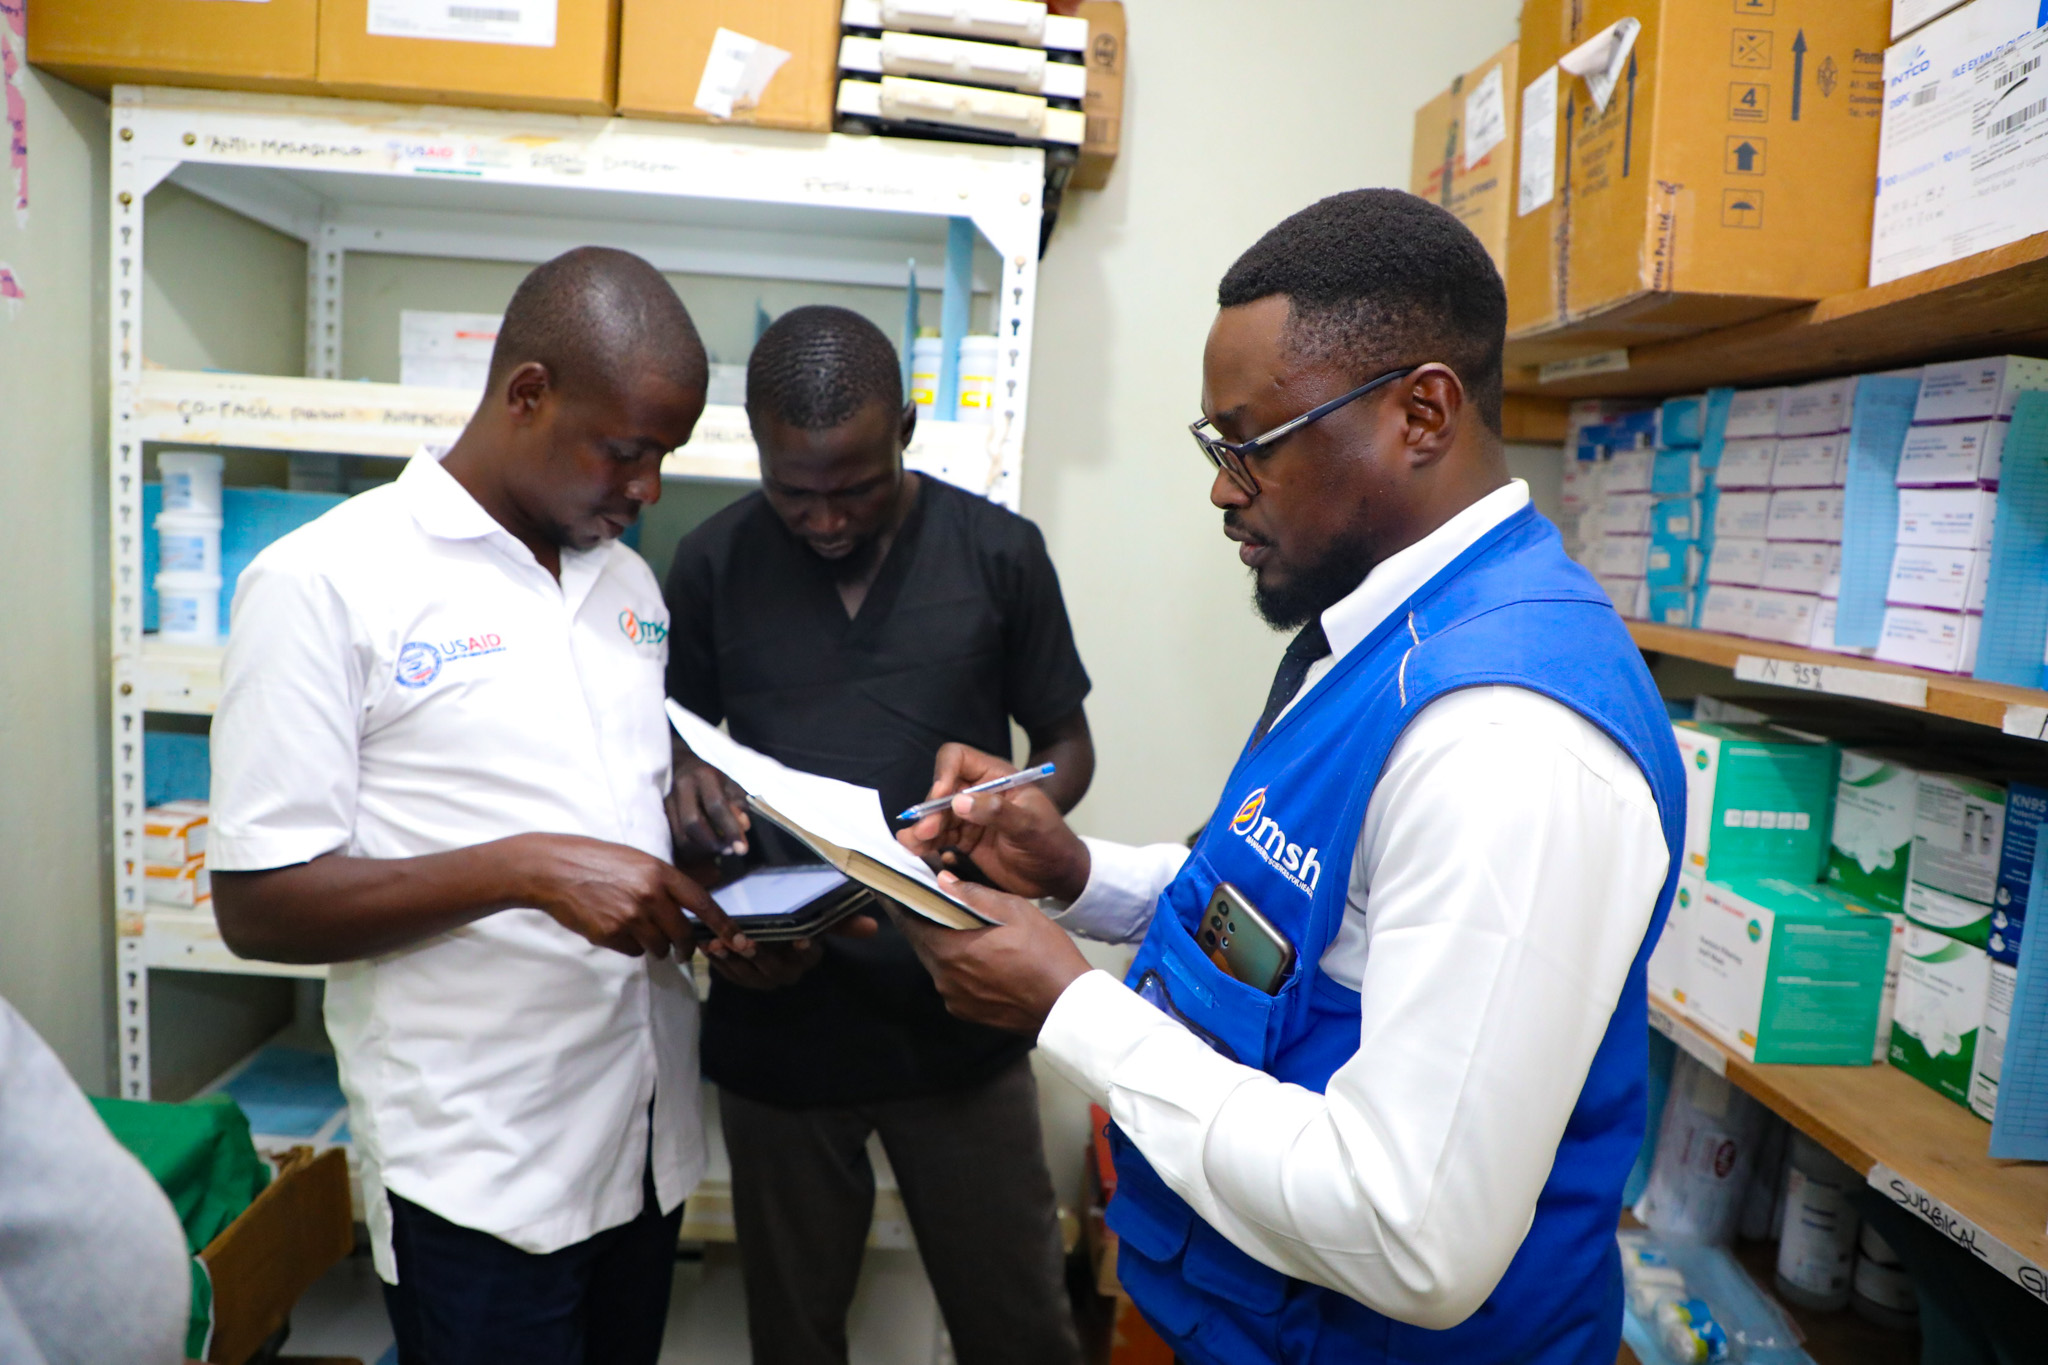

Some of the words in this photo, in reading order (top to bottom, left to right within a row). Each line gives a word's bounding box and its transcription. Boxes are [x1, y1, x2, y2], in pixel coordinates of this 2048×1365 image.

[1891, 60, 1930, 87] INTCO
[1741, 87, 1757, 107] 4
[405, 144, 453, 158] USAID
[440, 633, 502, 656] USAID
[1762, 659, 1779, 676] N
[2011, 793, 2047, 813] KN95
[1252, 816, 1321, 891] msh
[1890, 1179, 1988, 1258] SURGICAL
